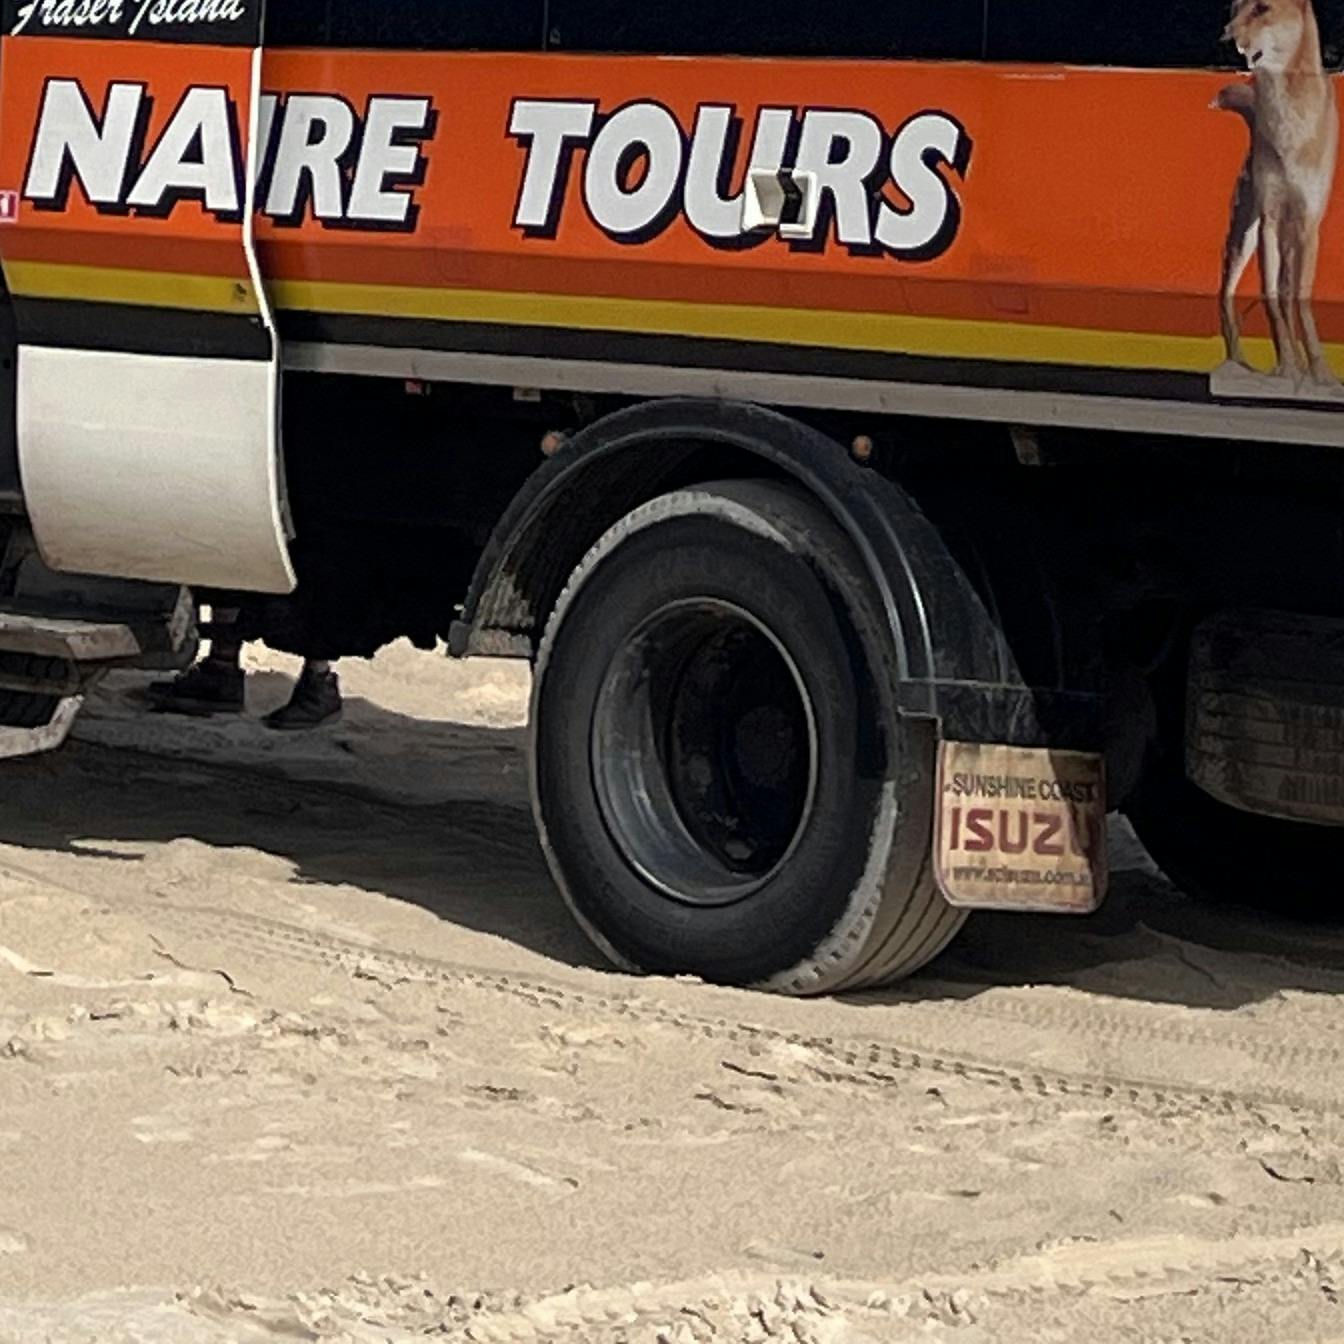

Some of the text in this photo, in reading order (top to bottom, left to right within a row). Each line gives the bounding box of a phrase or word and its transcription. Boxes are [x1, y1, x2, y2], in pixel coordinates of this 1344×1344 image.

[505, 97, 974, 265] TOURS
[952, 772, 1097, 803] SUNSHINE COAST
[949, 807, 1101, 856] ISUZU
